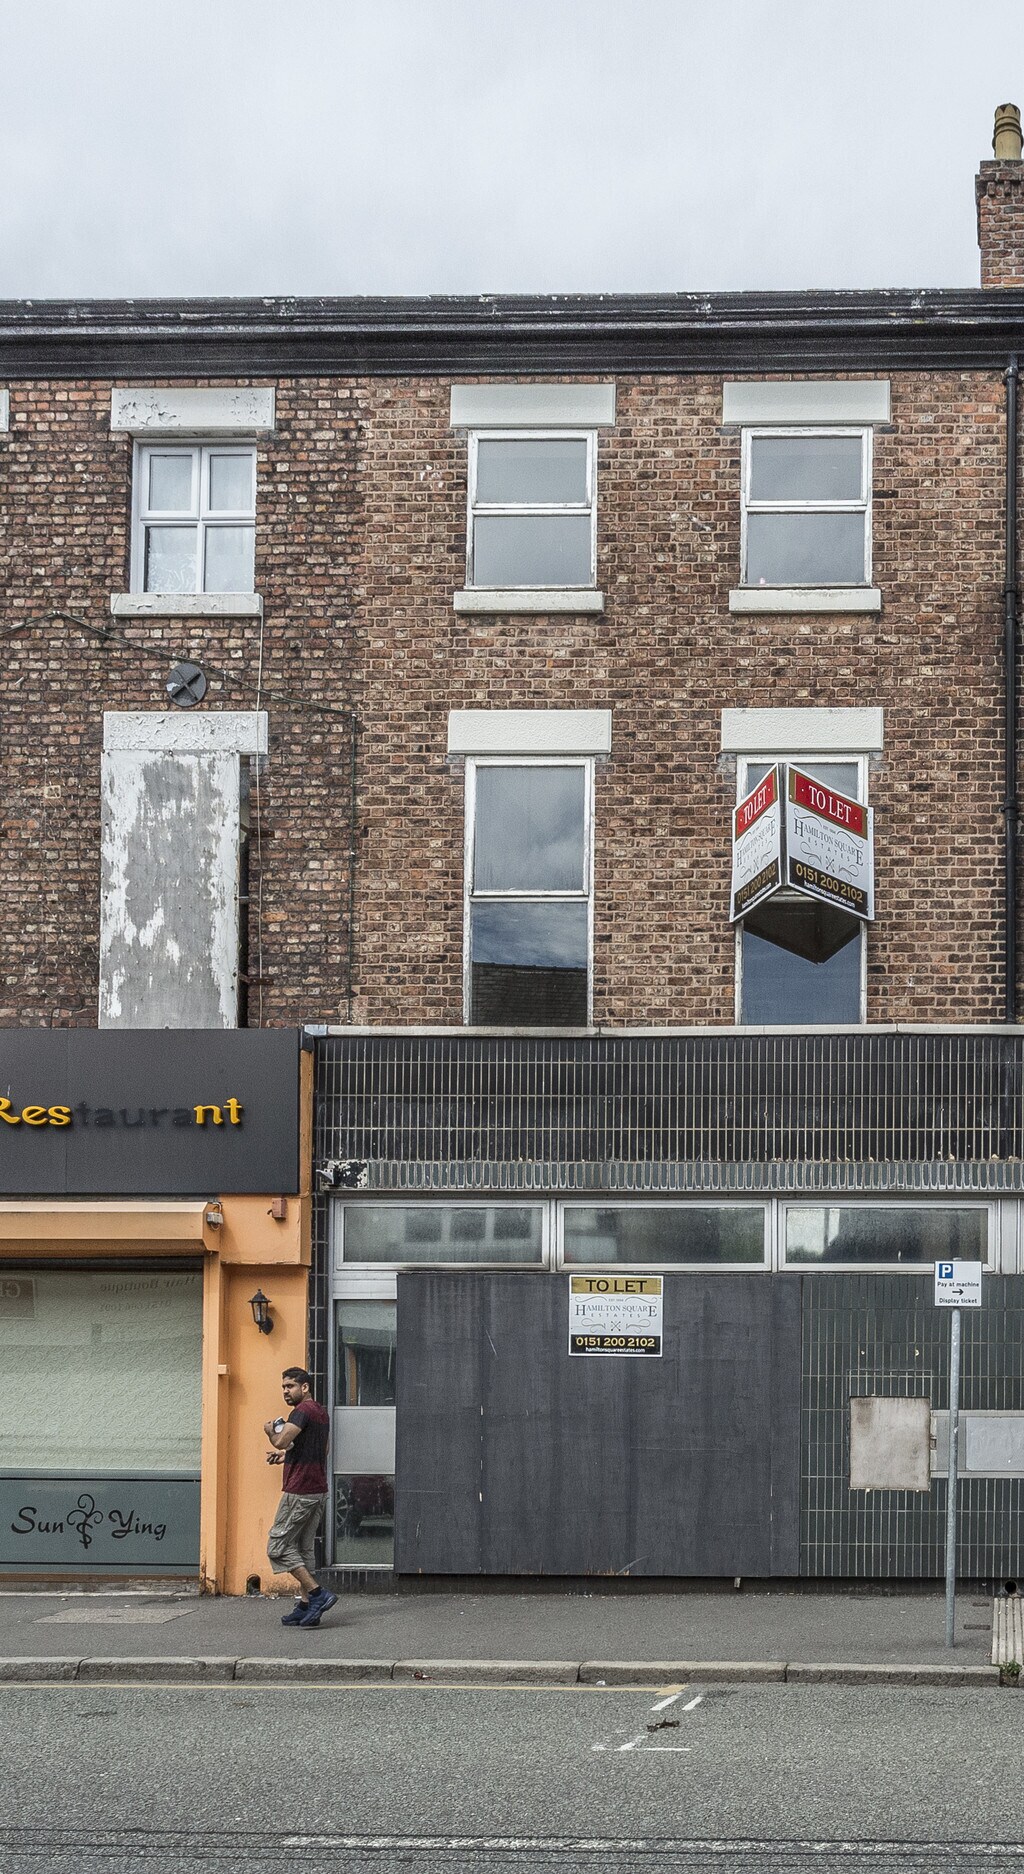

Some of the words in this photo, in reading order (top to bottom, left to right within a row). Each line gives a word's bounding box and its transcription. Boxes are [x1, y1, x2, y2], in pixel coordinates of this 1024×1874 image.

[744, 801, 753, 824] TO
[754, 785, 767, 815] LET
[808, 785, 826, 810] TO
[828, 795, 852, 824] LET
[794, 818, 833, 845] HAMILTON
[834, 838, 864, 867] SQUARE
[808, 837, 850, 862] ESTATES
[737, 885, 750, 904] 0151
[750, 876, 762, 893] 200
[762, 862, 777, 884] 2102
[795, 864, 818, 883] 0151
[820, 874, 839, 892] 200
[840, 883, 863, 903] 2102
[585, 1280, 609, 1292] TO
[614, 1280, 647, 1292] LET
[942, 1264, 951, 1278] P
[575, 1304, 621, 1316] HAMILTON
[622, 1305, 657, 1317] SQUARE
[576, 1337, 600, 1346] 0151
[603, 1338, 626, 1346] 200
[628, 1338, 655, 1347] 2102
[11, 1507, 64, 1534] Sun
[108, 1510, 166, 1541] Ying
